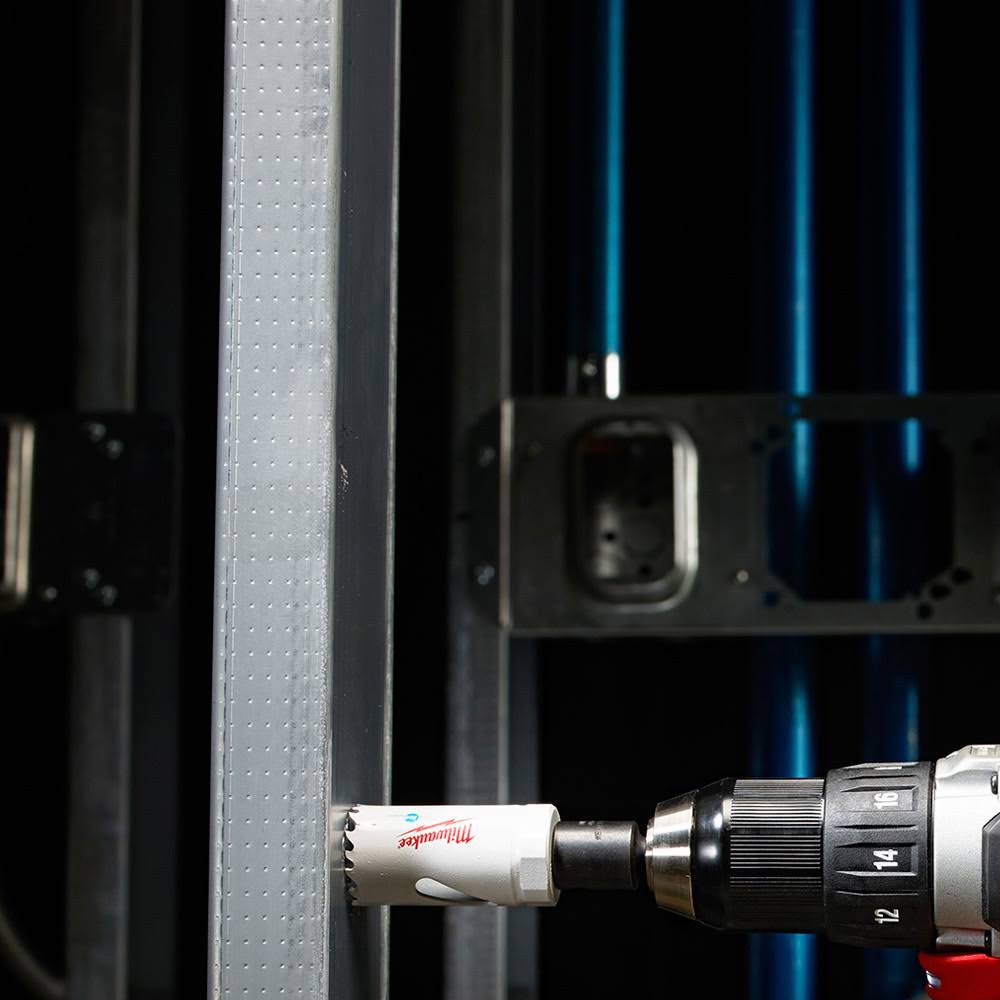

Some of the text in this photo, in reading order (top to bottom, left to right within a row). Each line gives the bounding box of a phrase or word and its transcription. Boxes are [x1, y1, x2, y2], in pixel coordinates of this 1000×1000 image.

[874, 791, 899, 809] 16
[398, 823, 476, 849] Milwaukee
[873, 849, 899, 870] 14
[874, 908, 900, 924] 12
